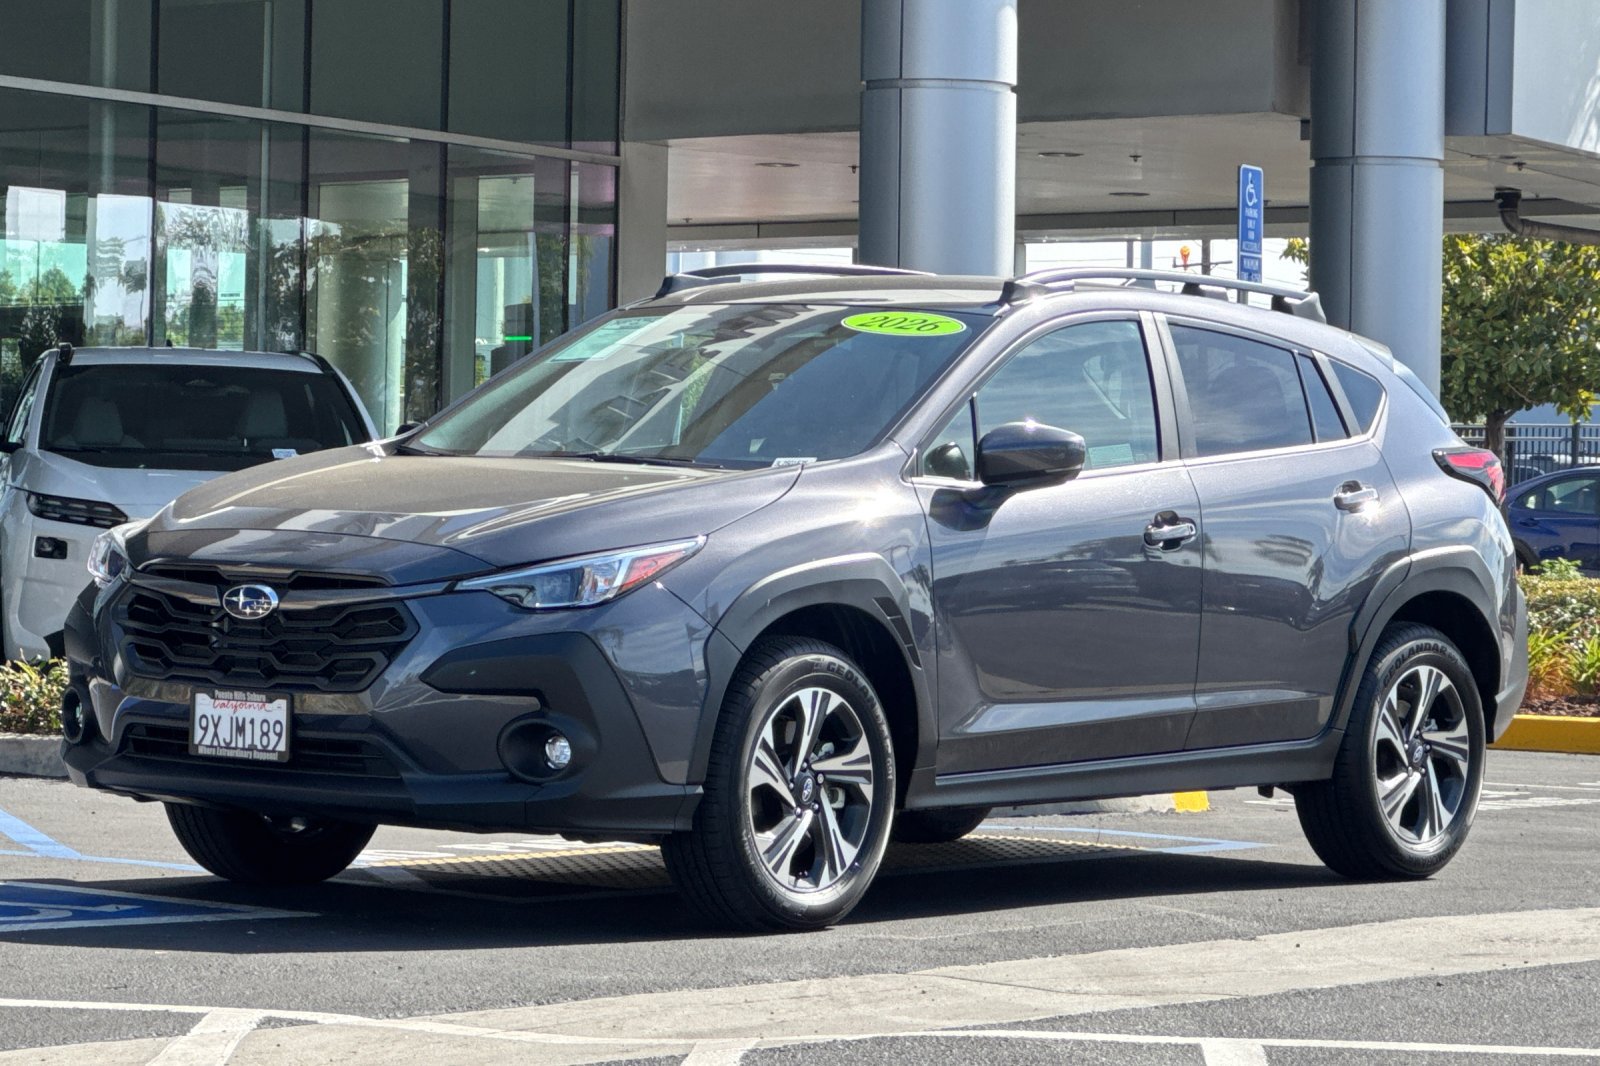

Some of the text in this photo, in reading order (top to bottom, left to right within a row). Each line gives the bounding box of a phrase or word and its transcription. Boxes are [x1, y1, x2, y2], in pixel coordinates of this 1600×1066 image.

[856, 315, 948, 332] 2026
[1383, 642, 1448, 688] GEOLANDAR
[234, 691, 247, 701] Hills
[247, 692, 266, 702] Subaru
[212, 700, 272, 714] California
[198, 714, 283, 751] 9XJM189
